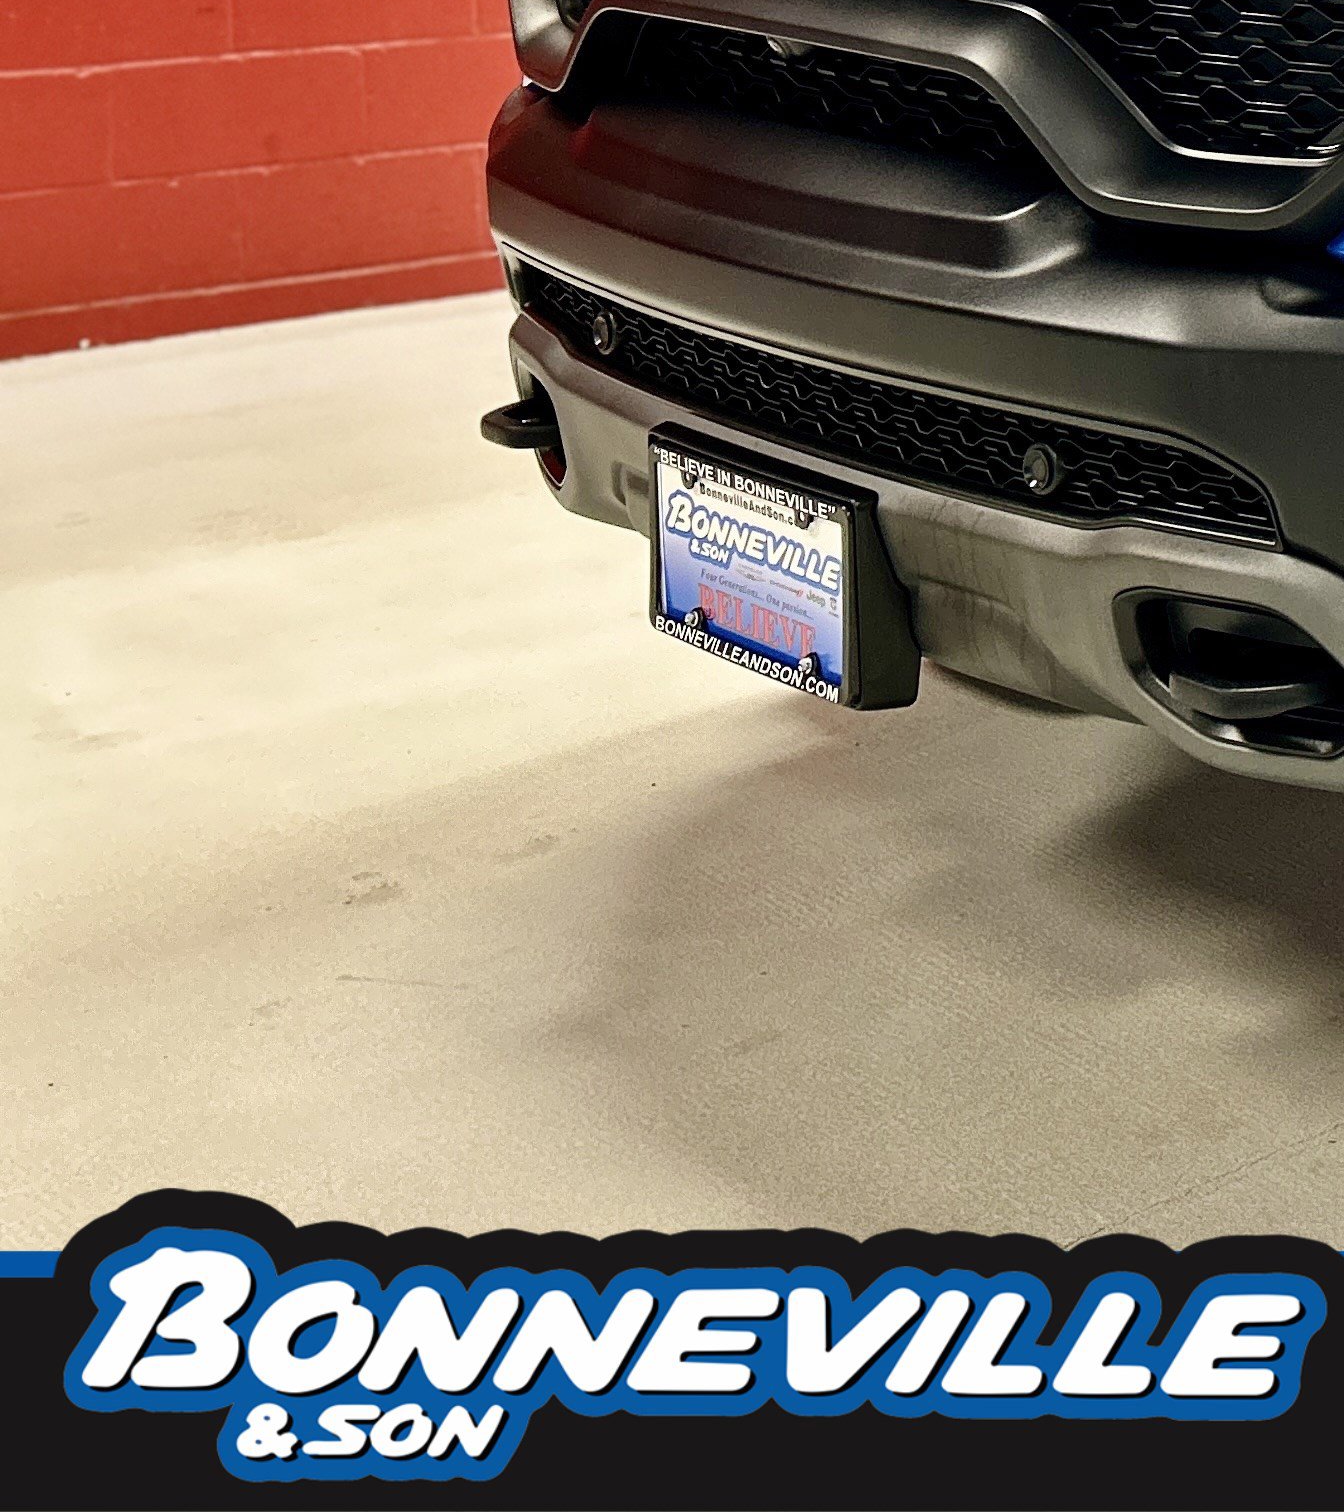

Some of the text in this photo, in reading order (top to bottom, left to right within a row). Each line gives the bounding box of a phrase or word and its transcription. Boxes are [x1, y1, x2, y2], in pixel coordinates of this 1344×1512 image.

[717, 469, 731, 488] IN
[667, 494, 841, 592] BONNEVILLE
[655, 614, 840, 704] BONNEVILLEANDSON.COM
